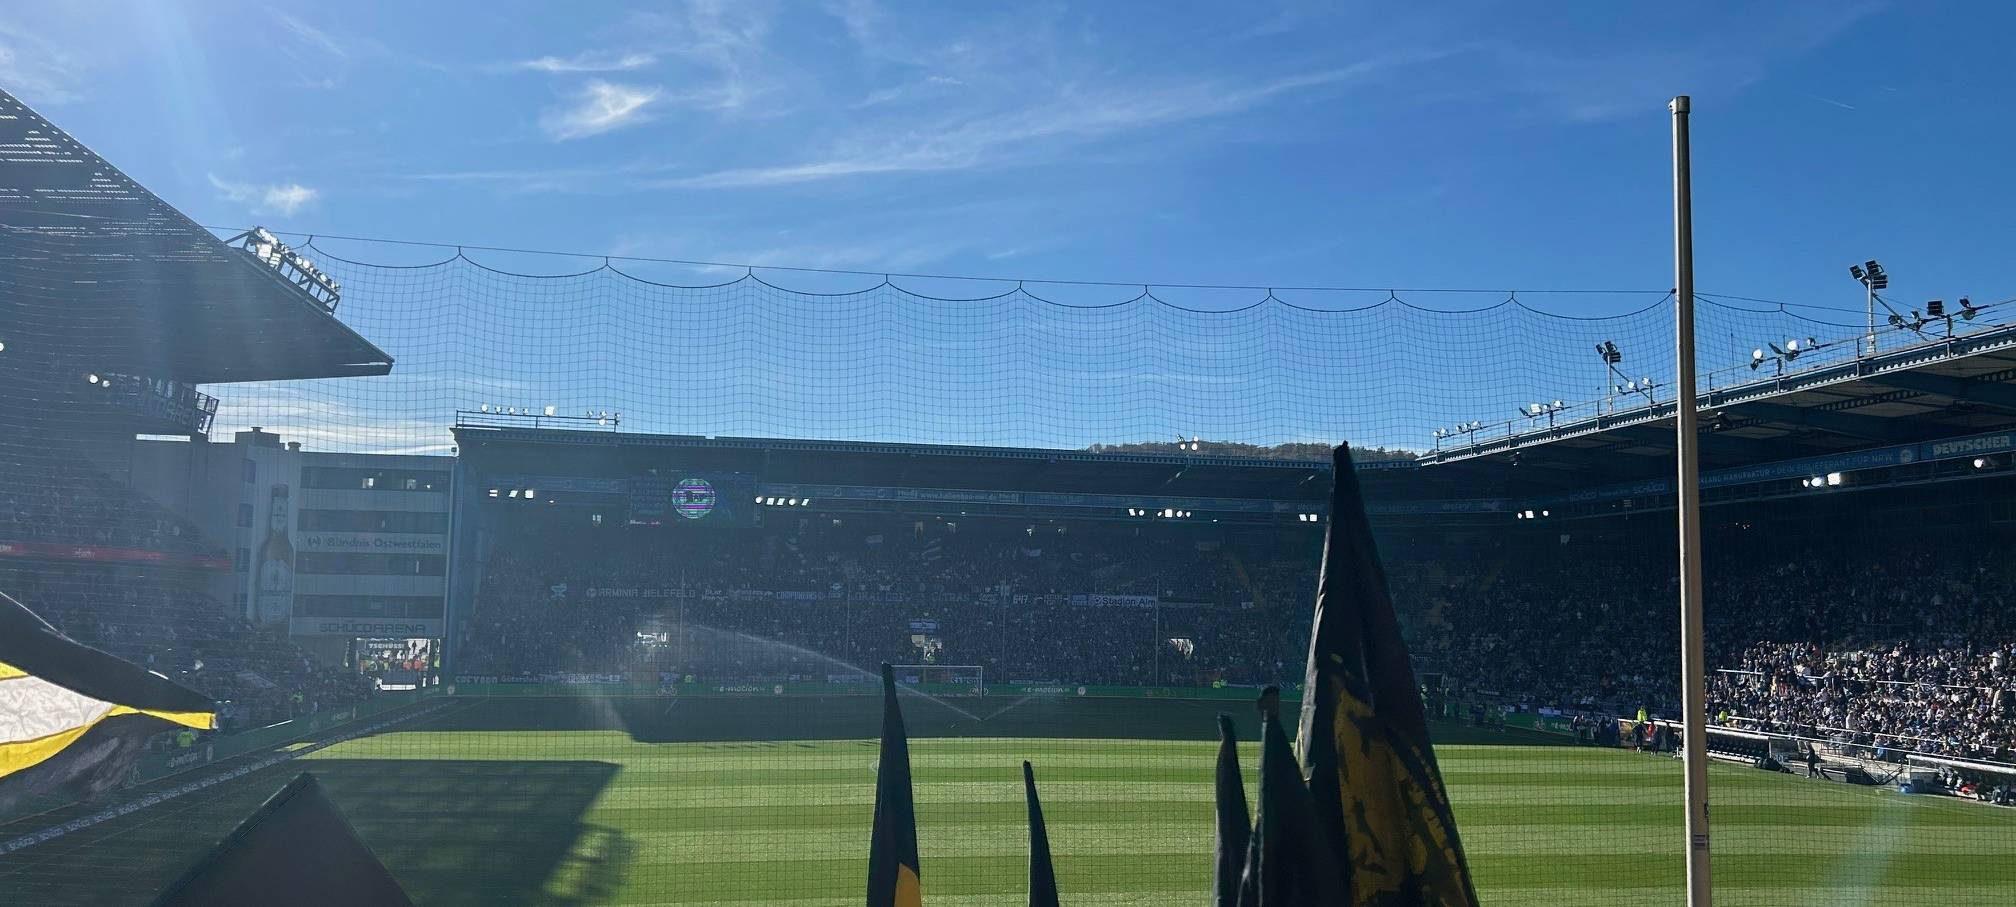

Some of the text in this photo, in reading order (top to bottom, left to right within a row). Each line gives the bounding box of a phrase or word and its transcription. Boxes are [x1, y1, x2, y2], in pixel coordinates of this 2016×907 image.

[1933, 435, 2010, 456] DEUTSCHER
[374, 538, 441, 549] Ostwestfalen
[598, 588, 638, 598] ARMINIA
[1102, 596, 1156, 606] Stadion Alm
